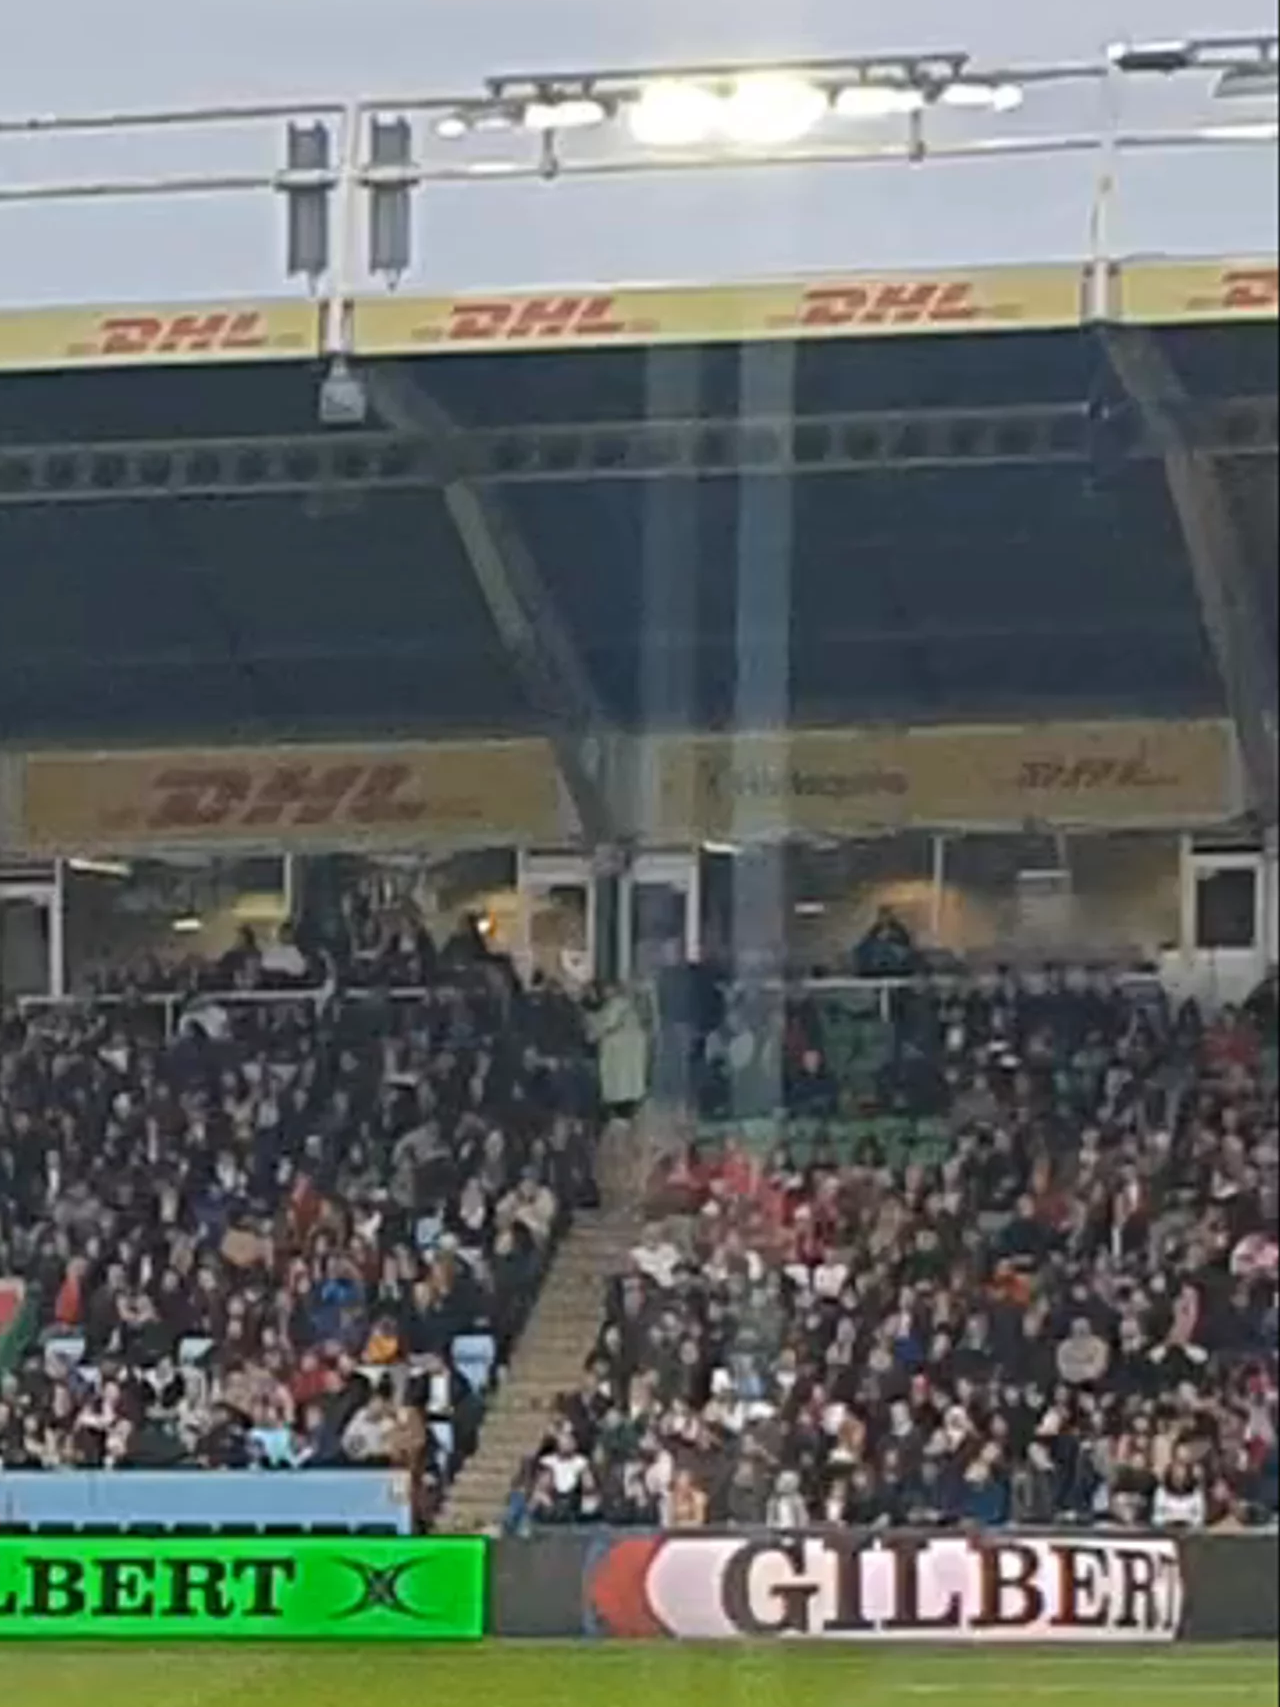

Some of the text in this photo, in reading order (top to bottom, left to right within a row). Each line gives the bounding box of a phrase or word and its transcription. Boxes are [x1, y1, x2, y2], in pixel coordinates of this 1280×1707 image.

[450, 298, 624, 339] DHL
[801, 283, 980, 324] DHL
[101, 314, 266, 353] DHL
[146, 766, 426, 827] DHL
